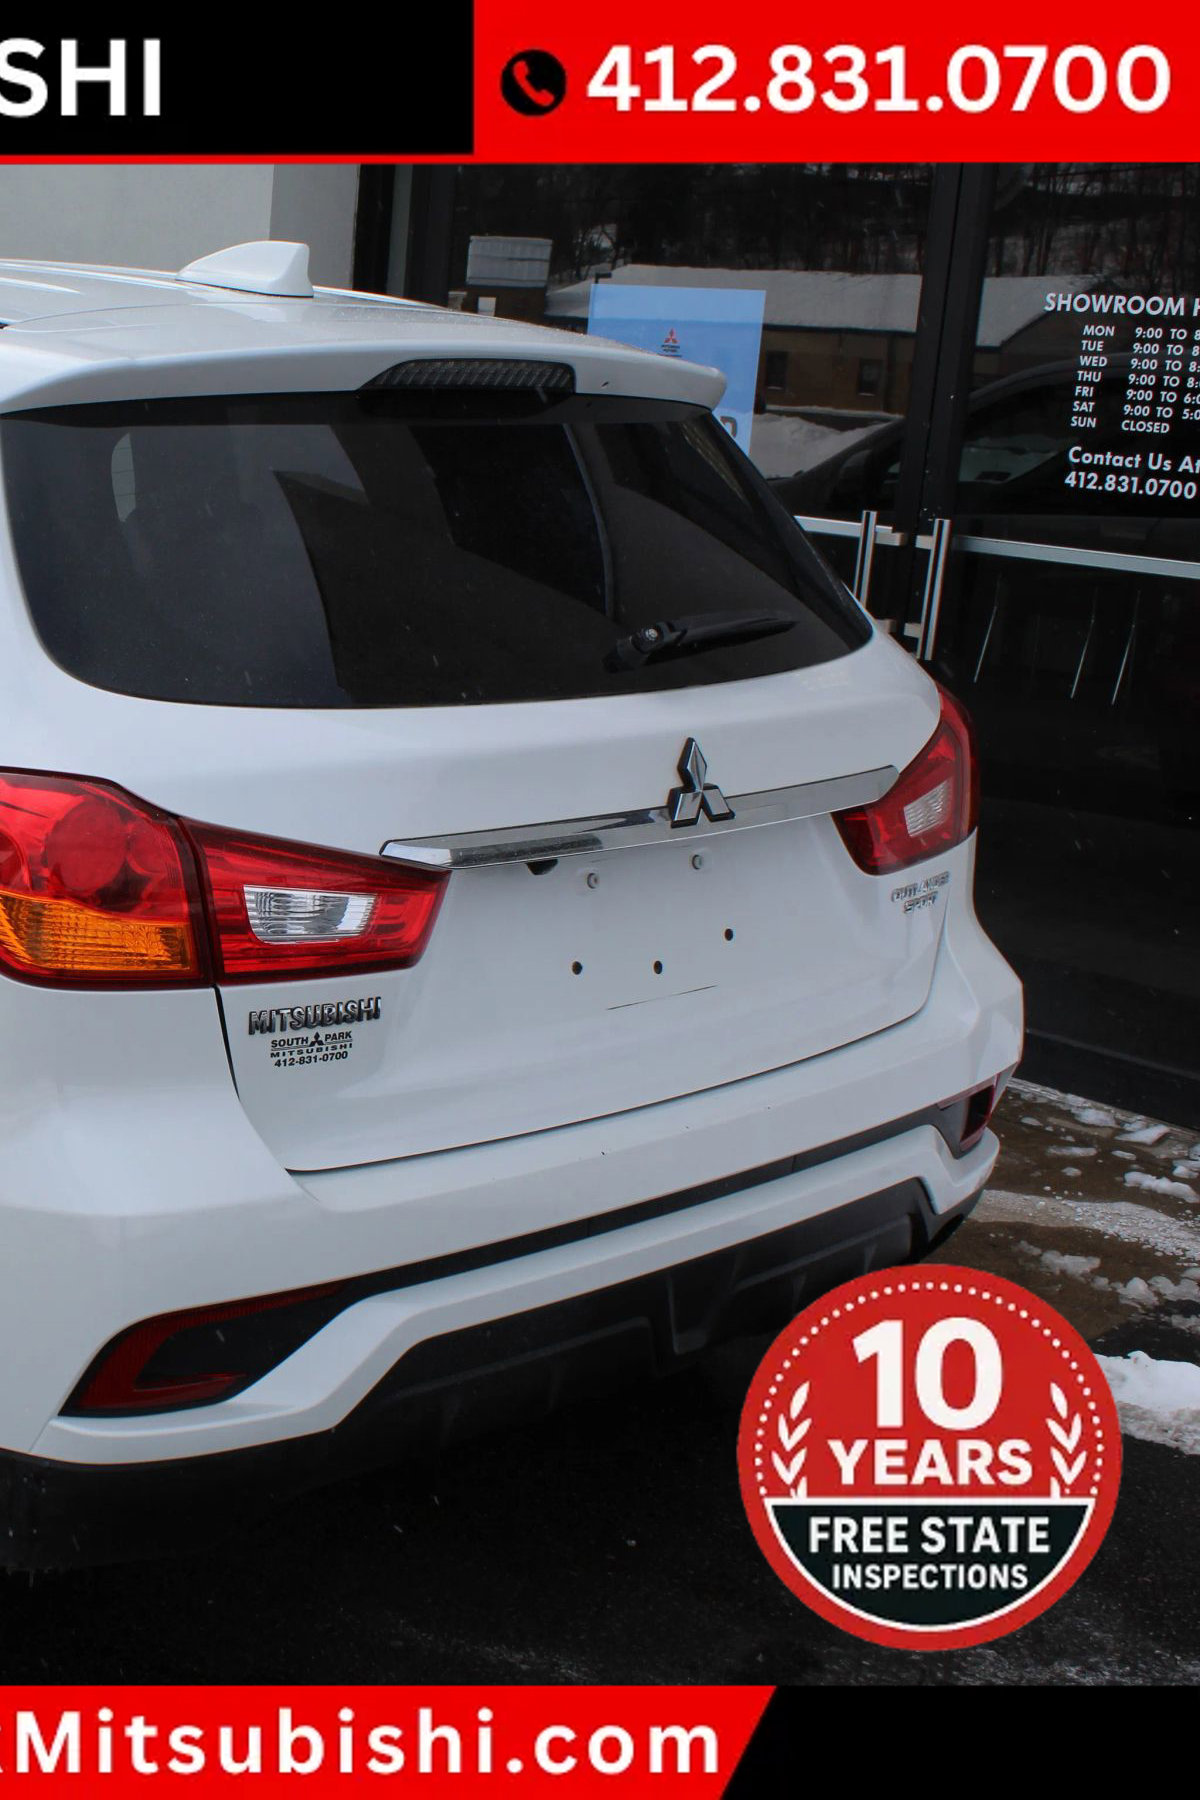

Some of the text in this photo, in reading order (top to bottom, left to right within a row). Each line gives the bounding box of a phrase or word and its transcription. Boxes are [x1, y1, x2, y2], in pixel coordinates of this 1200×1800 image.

[1044, 293, 1185, 317] SHOWROOM
[1083, 325, 1115, 337] MON
[1135, 327, 1163, 339] 9:00
[1170, 328, 1188, 340] TO
[1081, 340, 1104, 352] TUE
[1133, 342, 1160, 355] 9:00
[1166, 344, 1184, 356] TO
[1079, 355, 1108, 367] WED
[1130, 358, 1158, 370] 9:00
[1165, 360, 1182, 372] TO
[1077, 371, 1102, 383] THU
[1128, 373, 1156, 386] 9:00
[1163, 375, 1180, 387] TO
[1074, 386, 1094, 397] FRI
[1126, 389, 1153, 401] 9:00
[1160, 391, 1177, 403] TO
[1072, 401, 1095, 412] SAT
[1123, 404, 1150, 417] 9:00
[1156, 406, 1173, 418] TO
[1070, 416, 1170, 434] SUN CLOSED
[1068, 446, 1200, 474] Contact Us At
[1064, 471, 1197, 499] 412.831.0700
[248, 996, 381, 1035] MITSUBISHI
[271, 1031, 352, 1048] SOUTH PARK
[270, 1043, 353, 1058] MITSUBISHI
[274, 1051, 349, 1068] 412-831-0700
